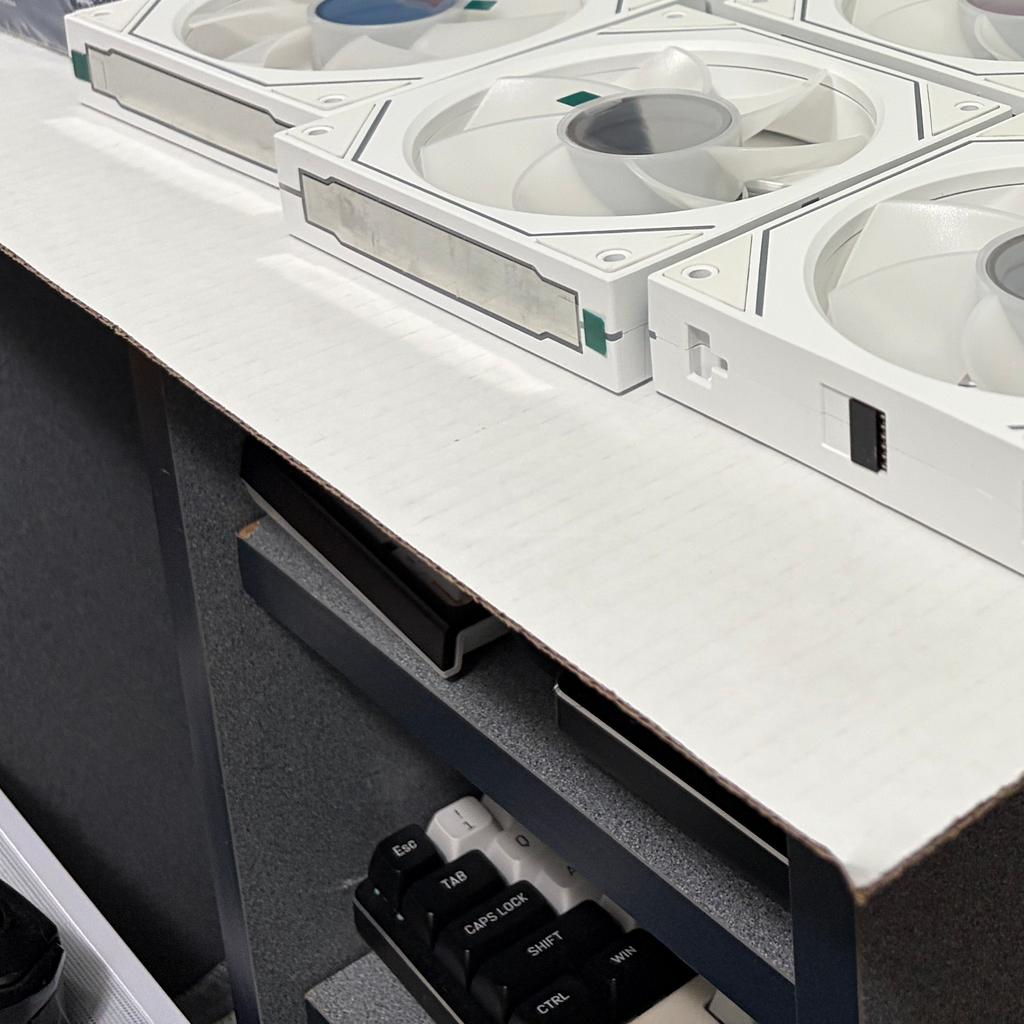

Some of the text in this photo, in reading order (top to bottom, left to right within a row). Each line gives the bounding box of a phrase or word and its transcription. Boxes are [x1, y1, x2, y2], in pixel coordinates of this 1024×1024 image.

[392, 838, 418, 858] Esc
[515, 833, 531, 848] Q
[440, 869, 468, 891] TAB
[464, 891, 529, 936] CAPS LOCK
[526, 929, 564, 958] SHIFT
[610, 945, 638, 967] WIN
[535, 990, 571, 1016] CTRL
